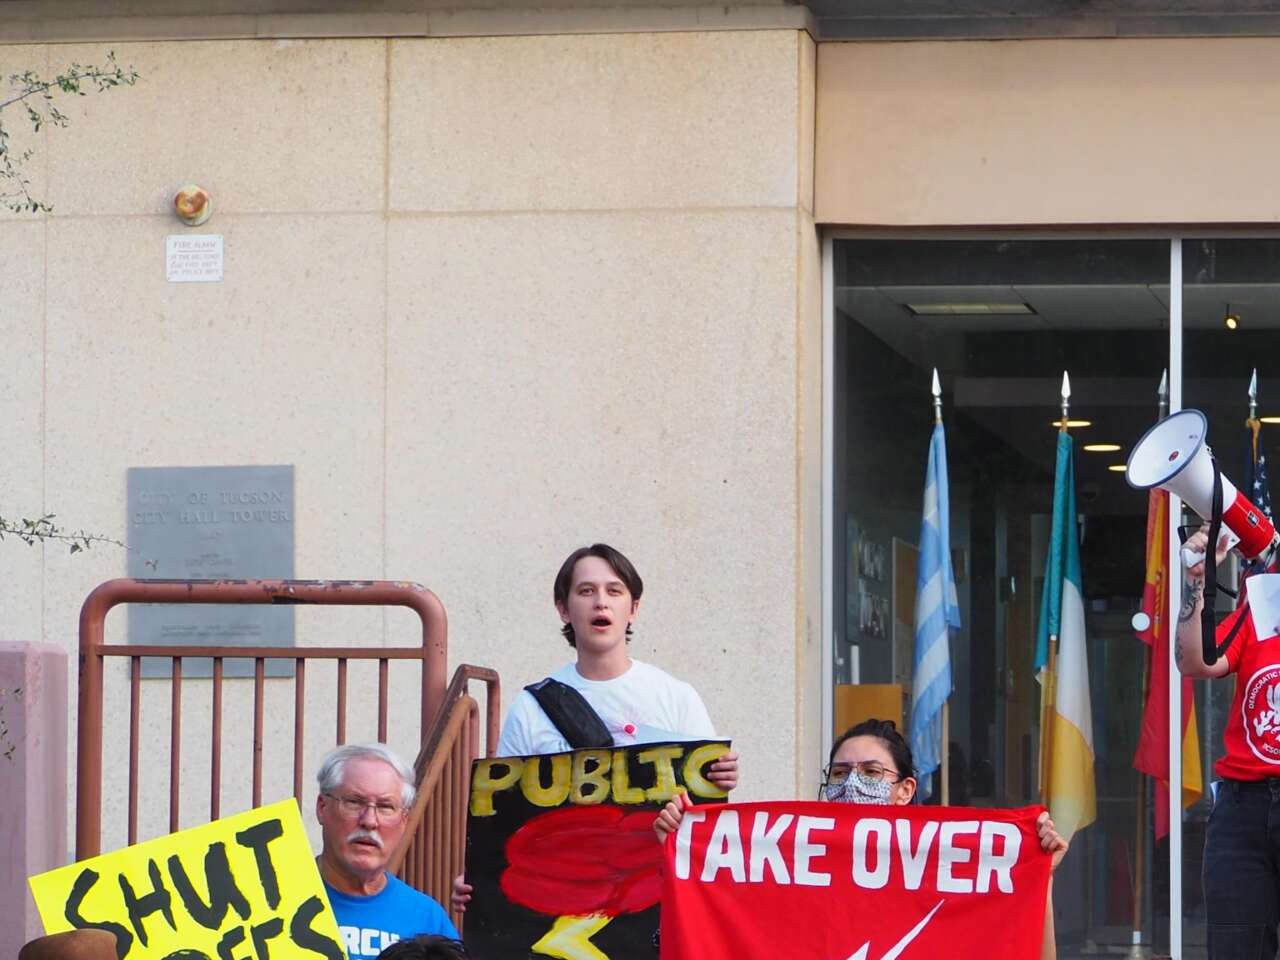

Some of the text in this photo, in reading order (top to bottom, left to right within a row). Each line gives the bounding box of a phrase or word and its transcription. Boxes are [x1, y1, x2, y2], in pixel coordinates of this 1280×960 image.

[219, 491, 282, 505] TUCSON
[232, 511, 291, 524] TOWER
[1248, 671, 1279, 710] DEMOCRATIC
[470, 743, 730, 817] PUBLIC
[675, 809, 1023, 894] TAKE OVER
